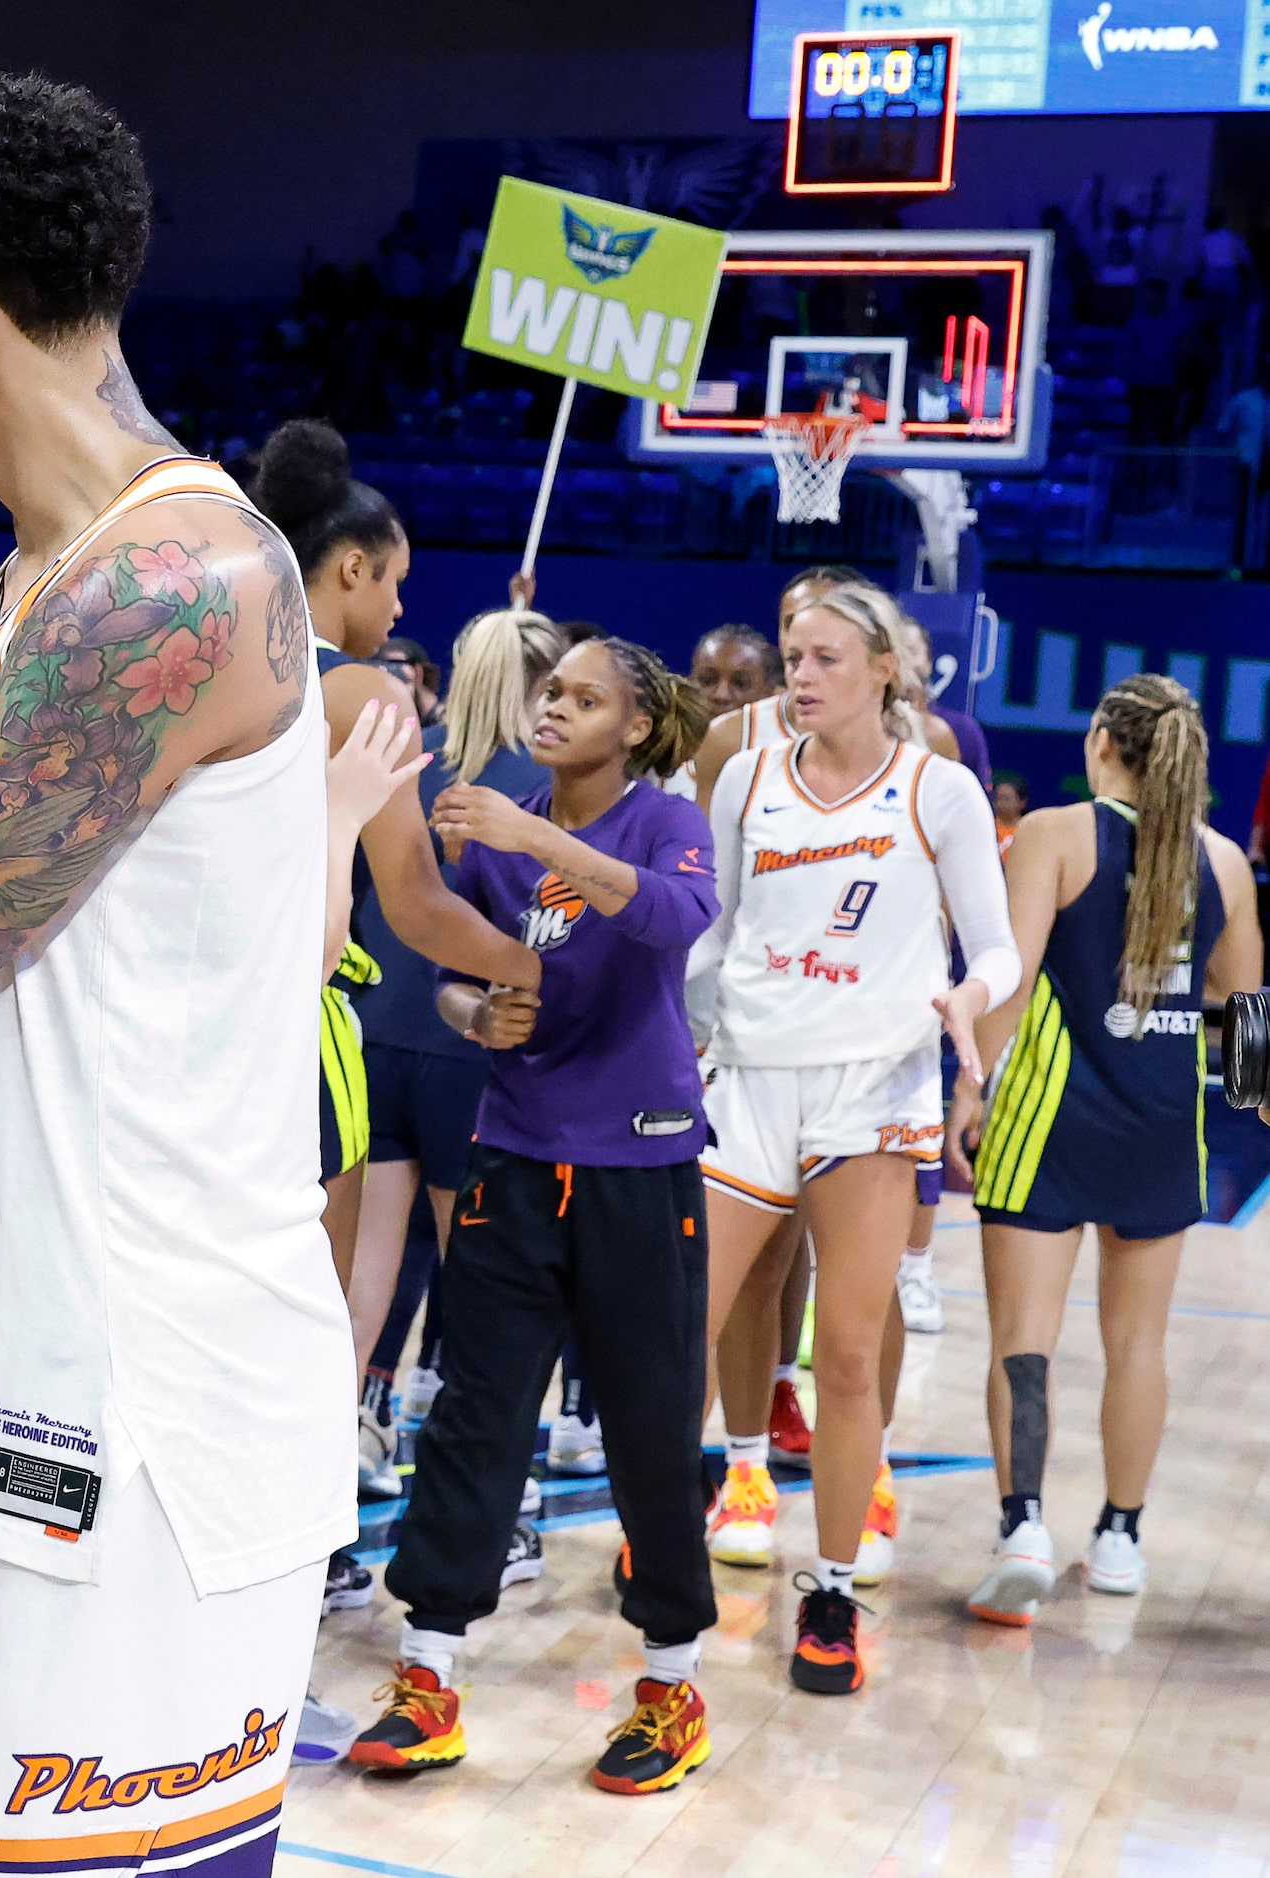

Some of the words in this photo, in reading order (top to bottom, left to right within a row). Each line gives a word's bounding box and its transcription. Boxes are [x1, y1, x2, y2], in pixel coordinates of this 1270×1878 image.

[1102, 25, 1219, 52] WNBA
[814, 50, 914, 97] 00.0
[488, 266, 695, 393] WIN!
[752, 834, 897, 877] Mercury
[825, 880, 879, 937] 9
[1141, 1010, 1203, 1035] AT&T
[2, 1420, 49, 1444] HEROINE
[51, 1432, 98, 1457] EDITION
[35, 1412, 93, 1438] Mercury
[5, 1707, 289, 1815] Phoenix
